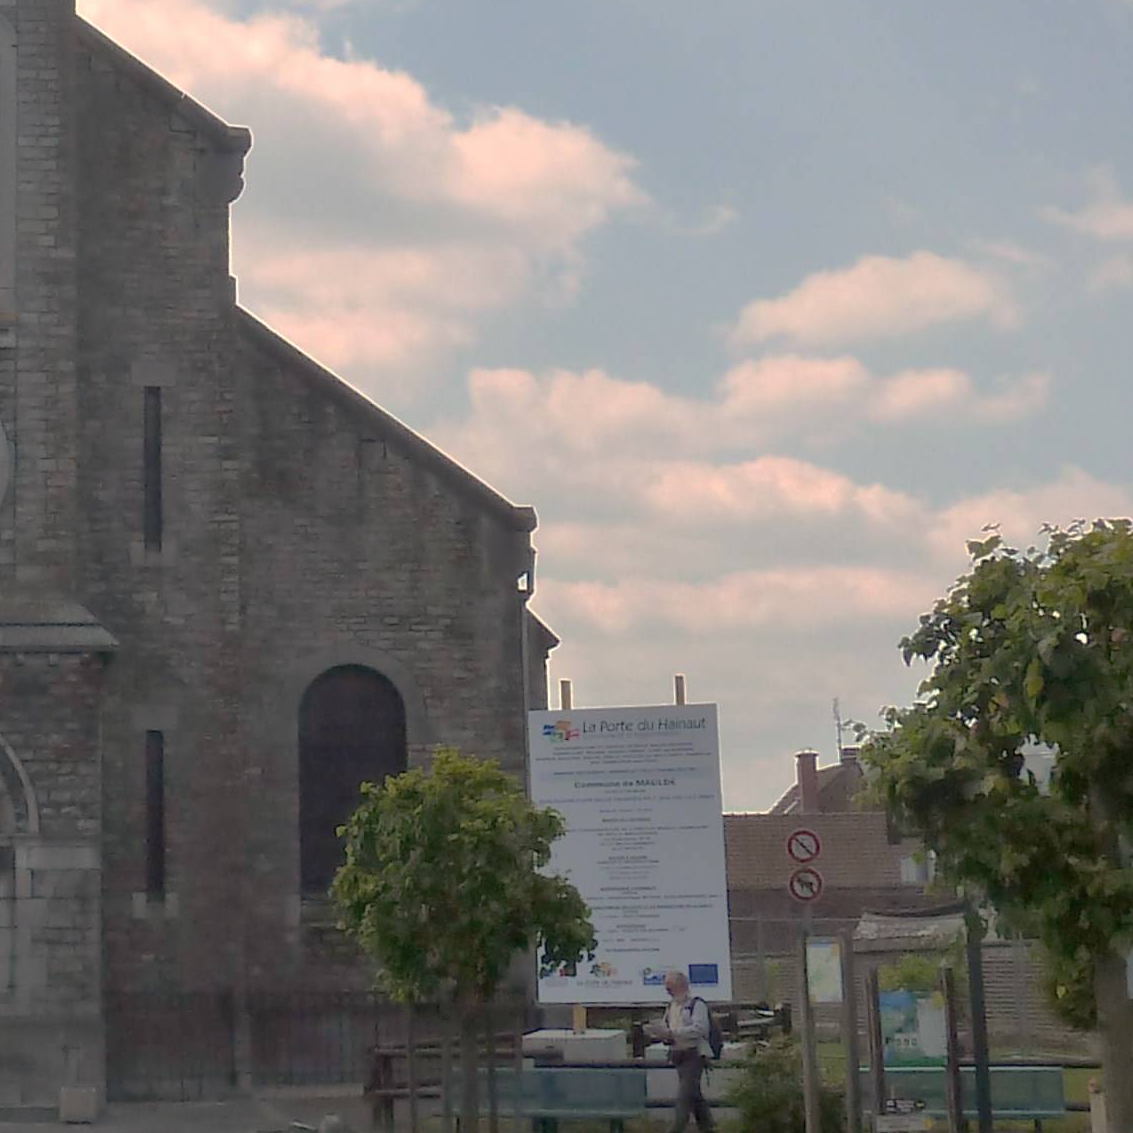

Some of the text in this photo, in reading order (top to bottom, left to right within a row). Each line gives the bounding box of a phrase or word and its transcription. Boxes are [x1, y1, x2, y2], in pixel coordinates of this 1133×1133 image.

[582, 716, 706, 733] La Porte du Hainaut
